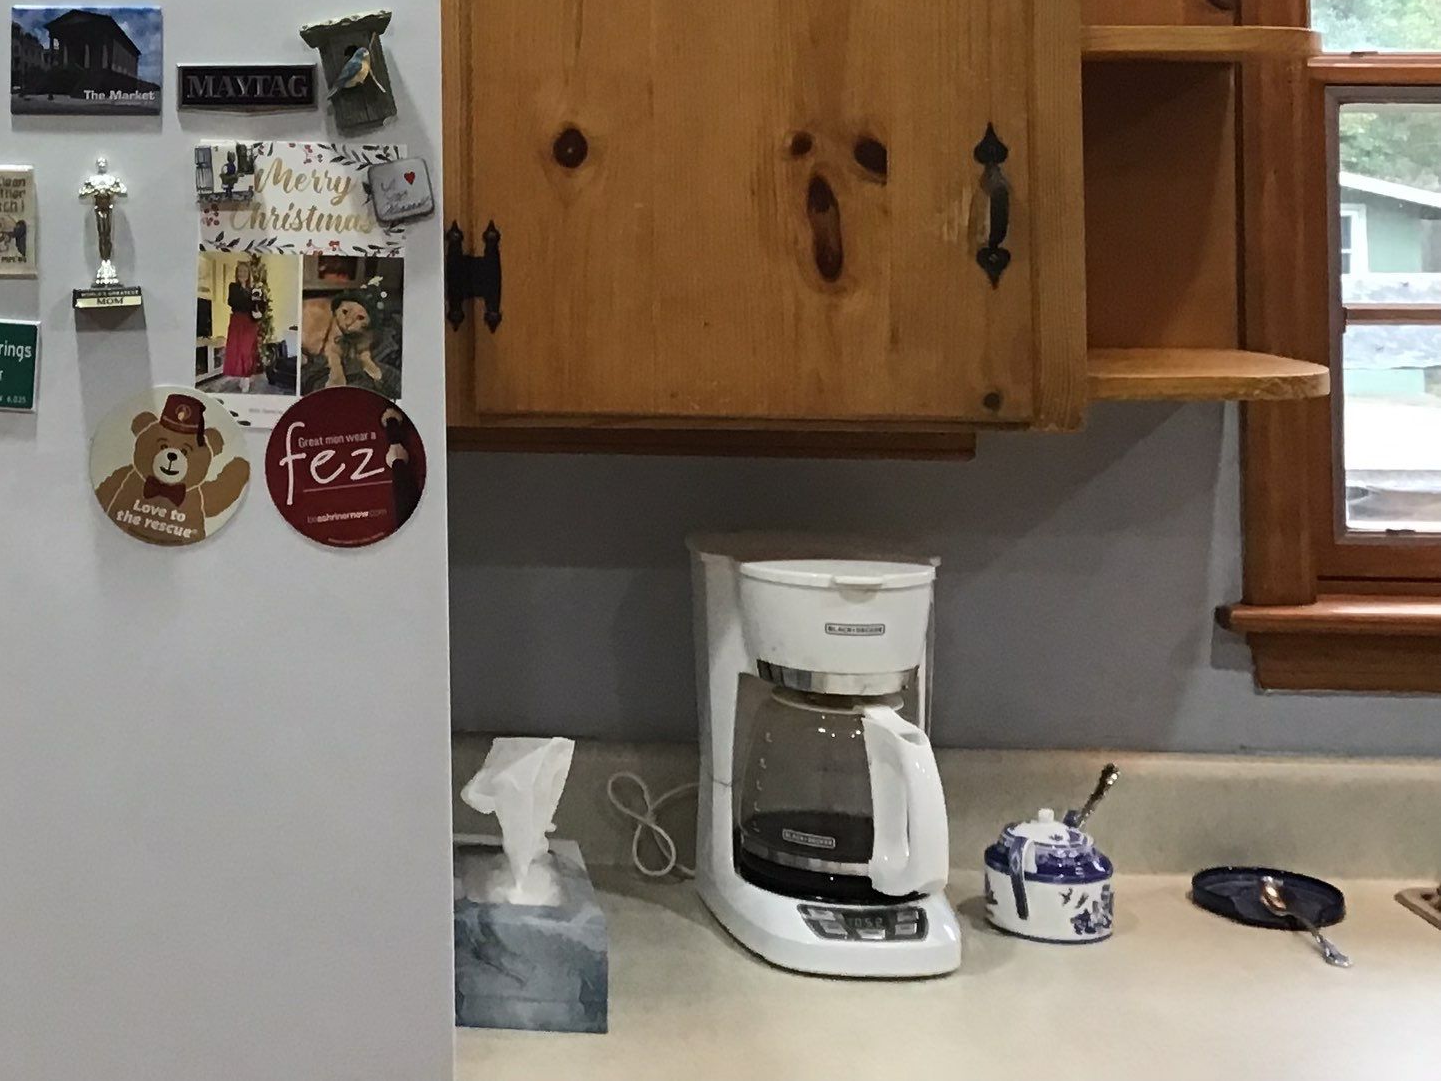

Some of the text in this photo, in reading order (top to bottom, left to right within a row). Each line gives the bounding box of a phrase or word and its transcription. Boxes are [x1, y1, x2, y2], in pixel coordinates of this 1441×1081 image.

[84, 90, 155, 101] The Market
[187, 75, 307, 98] MAYTAG
[254, 157, 351, 206] Merry
[230, 202, 374, 234] Christmas
[298, 437, 323, 448] Great
[345, 432, 368, 443] wear
[370, 431, 377, 440] a
[279, 421, 385, 506] fez
[133, 499, 186, 522] Love to
[116, 510, 192, 538] the rescue
